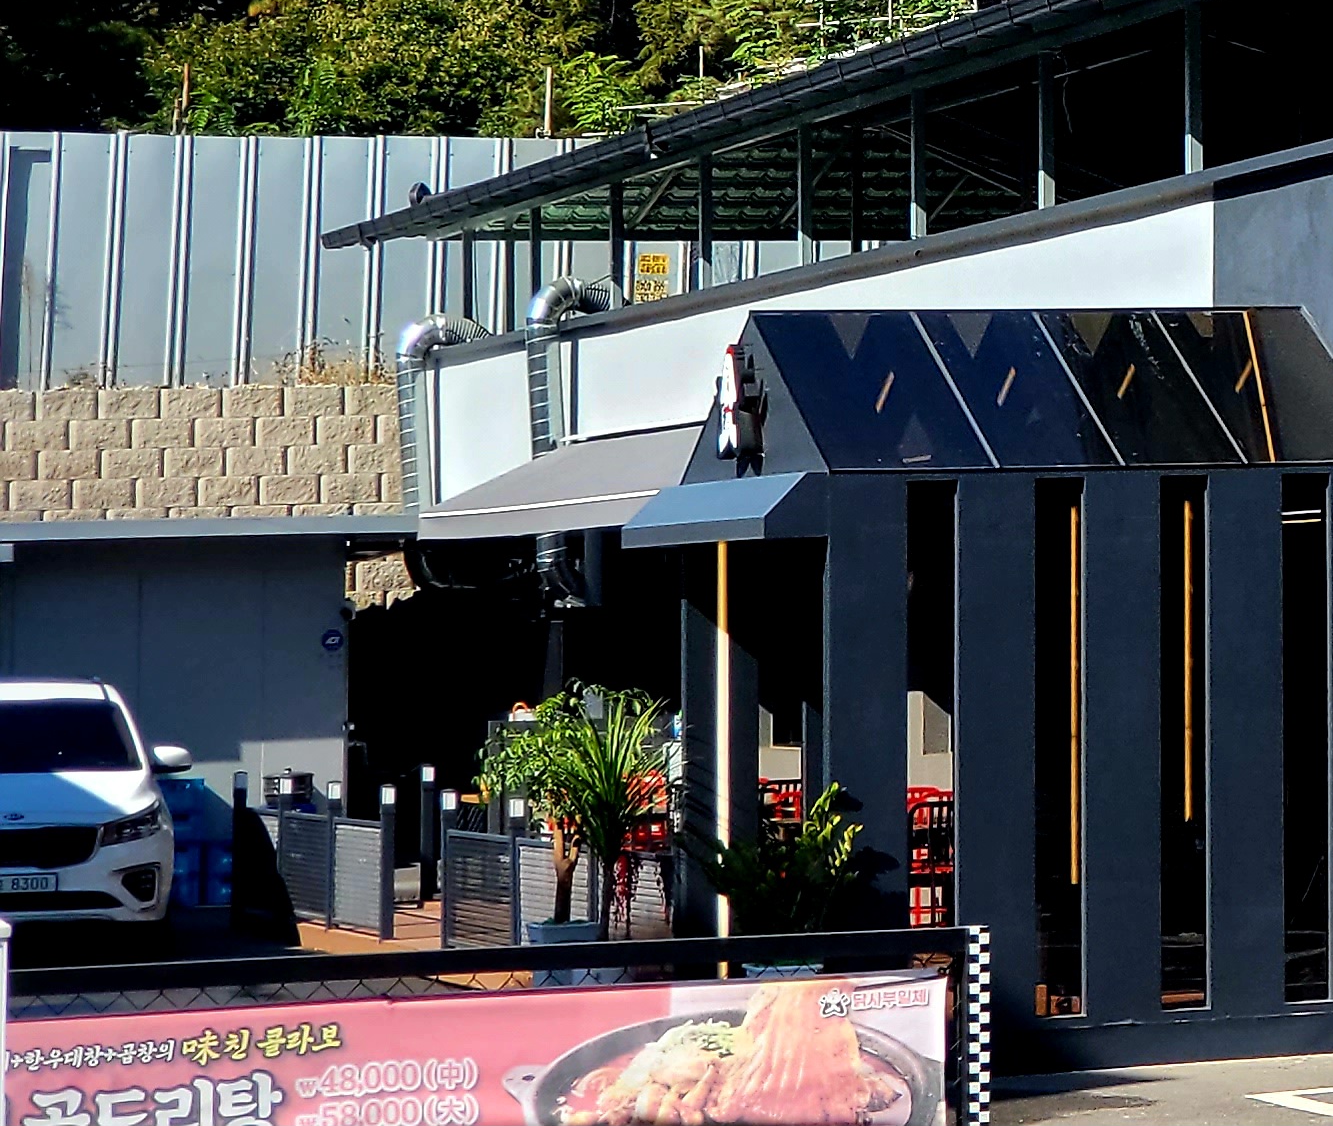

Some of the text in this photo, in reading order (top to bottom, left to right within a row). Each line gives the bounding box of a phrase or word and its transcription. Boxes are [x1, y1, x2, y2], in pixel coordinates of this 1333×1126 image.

[11, 877, 49, 890] 8300
[181, 1028, 251, 1066] 味친
[256, 1023, 342, 1058] 콜라보
